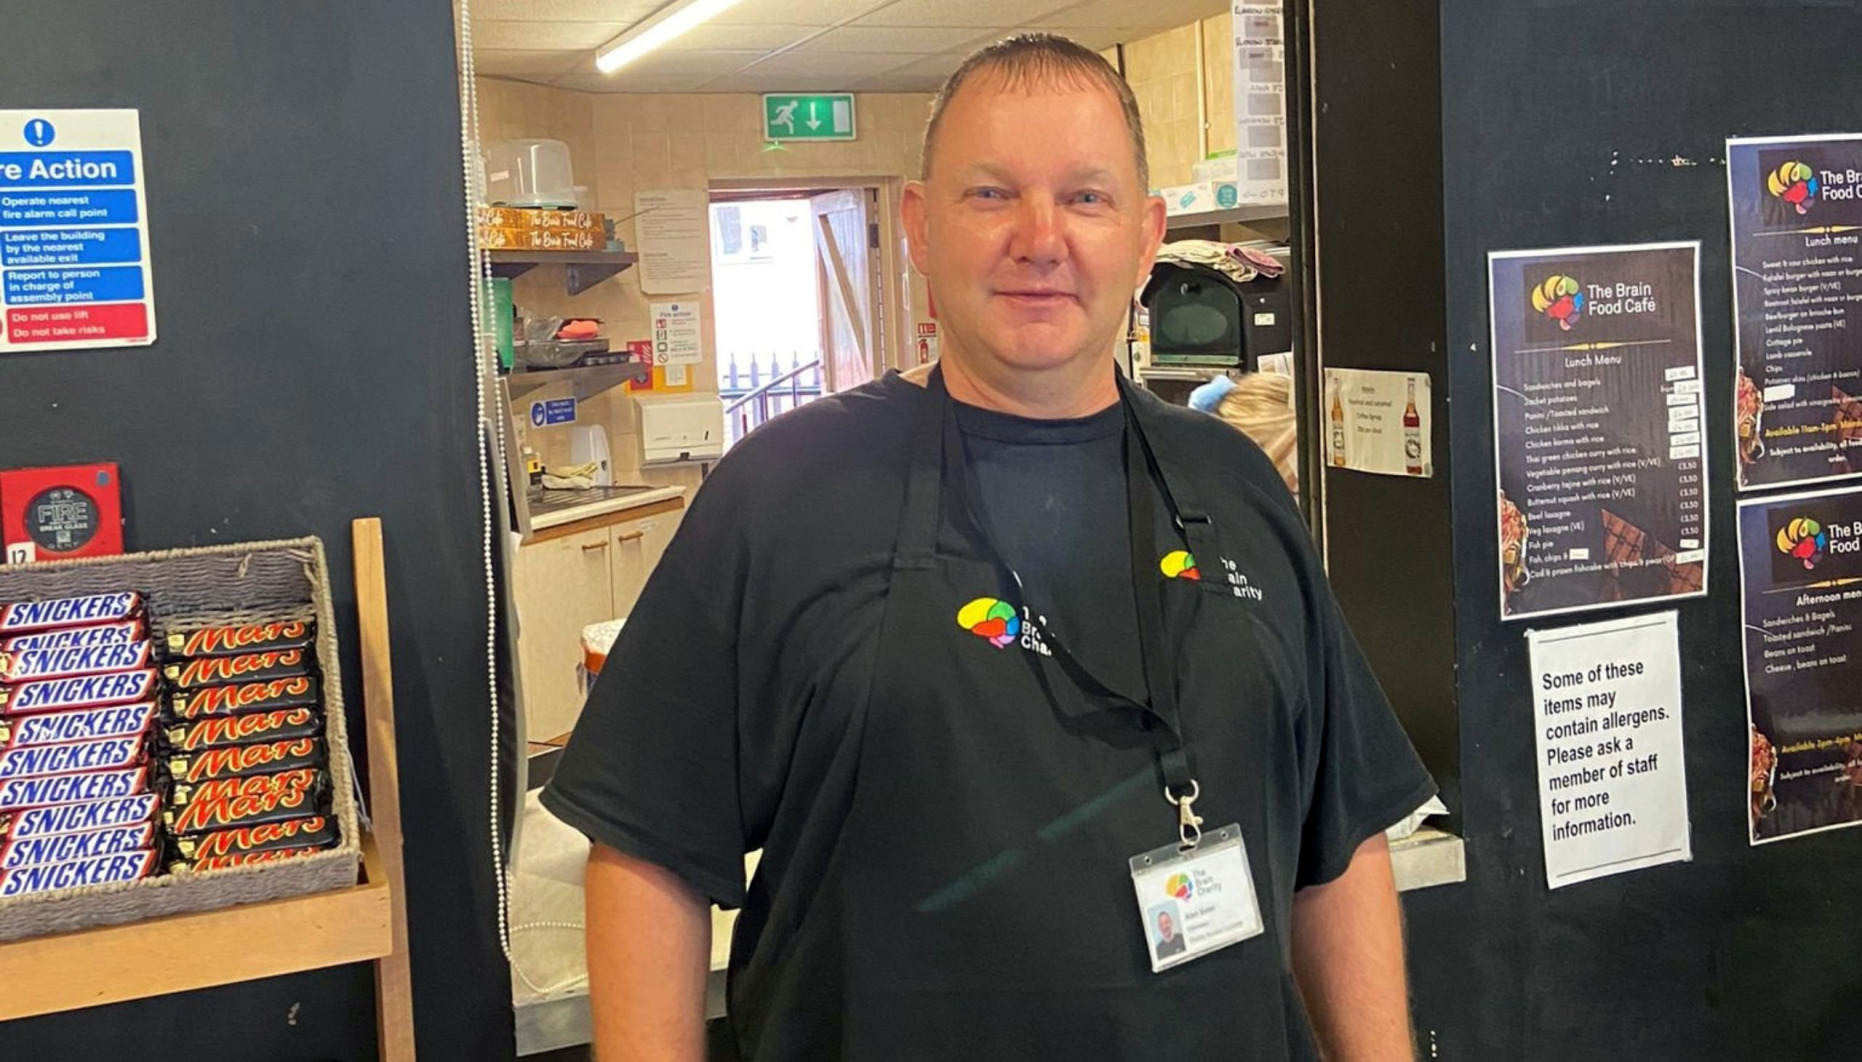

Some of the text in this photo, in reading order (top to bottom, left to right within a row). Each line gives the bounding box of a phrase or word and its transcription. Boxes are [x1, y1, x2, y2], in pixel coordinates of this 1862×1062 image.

[29, 158, 117, 180] Action
[1820, 171, 1844, 184] The
[1822, 186, 1854, 200] Food
[2, 196, 89, 208] Operate nearest
[3, 208, 108, 218] fire alarm call point
[5, 232, 105, 242] Leave the building
[1806, 235, 1858, 247] Lunch menu
[6, 243, 84, 254] by the nearest
[7, 253, 78, 264] available exit
[8, 270, 100, 282] Report to person
[9, 281, 74, 292] in charge of
[1588, 282, 1652, 299] The Brain
[10, 292, 94, 302] assembly point
[1589, 297, 1656, 316] Food Café
[12, 310, 88, 322] Do not use lift
[14, 326, 105, 338] Do not take risks
[1766, 339, 1792, 348] Cottage
[1565, 354, 1622, 368] Lunch Menu
[1524, 378, 1601, 391] Sandwiches and bagels
[1548, 396, 1578, 405] potatoes
[1578, 404, 1609, 415] sandwich
[1525, 426, 1552, 434] Chicken
[1571, 422, 1584, 430] with
[1765, 424, 1800, 438] Available
[1526, 440, 1552, 448] Chicken
[1554, 438, 1574, 446] korma
[1576, 435, 1590, 443] with
[1526, 455, 1540, 463] Thai
[1542, 455, 1560, 464] green
[1562, 450, 1588, 460] chicken
[1607, 447, 1621, 455] with
[1770, 447, 1794, 458] Subject
[1526, 468, 1560, 479] Vegetable
[1562, 466, 1588, 476] penang
[1589, 464, 1606, 472] curry
[1607, 461, 1621, 470] with
[1527, 482, 1560, 492] Cranberry
[1582, 477, 1596, 486] with
[1527, 497, 1556, 507] Butternut
[1558, 493, 1580, 505] squash
[1582, 492, 1596, 500] with
[38, 502, 88, 524] FIRE
[1528, 510, 1571, 520] Beef lasagne
[1542, 524, 1569, 534] lasagne
[1828, 525, 1851, 539] The
[1830, 538, 1860, 554] Food
[1796, 592, 1841, 606] Afternoon
[7, 592, 132, 626] SNICKERS
[1763, 608, 1836, 628] Sandwiches Bagels
[184, 621, 305, 656] Mars
[1763, 630, 1792, 642] Toasted
[1793, 625, 1825, 639] sandwich
[19, 642, 142, 675] SNICKERS
[1764, 650, 1786, 658] Beans
[1798, 644, 1816, 654] toast
[179, 648, 302, 688] Mars
[1765, 654, 1847, 674] Cheese beans on toast
[1543, 660, 1644, 691] Some of these
[16, 673, 147, 707] SNICKERS
[184, 676, 308, 718] Mars
[1544, 691, 1616, 716] items may
[18, 706, 149, 744] SNICKERS
[184, 708, 310, 750] Mars
[1546, 706, 1670, 740] contain allergens.
[0, 740, 134, 776] SNICKERS
[1547, 736, 1634, 766] Please ask a
[187, 738, 313, 782] Mars
[1550, 754, 1658, 791] member of staff
[2, 772, 136, 806] SNICKERS
[175, 788, 304, 834] Mars
[1552, 790, 1610, 816] for more
[17, 796, 154, 836] SNICKERS
[1552, 810, 1636, 842] information.
[194, 816, 325, 860] Mars
[7, 826, 146, 868] SNICKERS
[4, 854, 146, 895] SNICKERS
